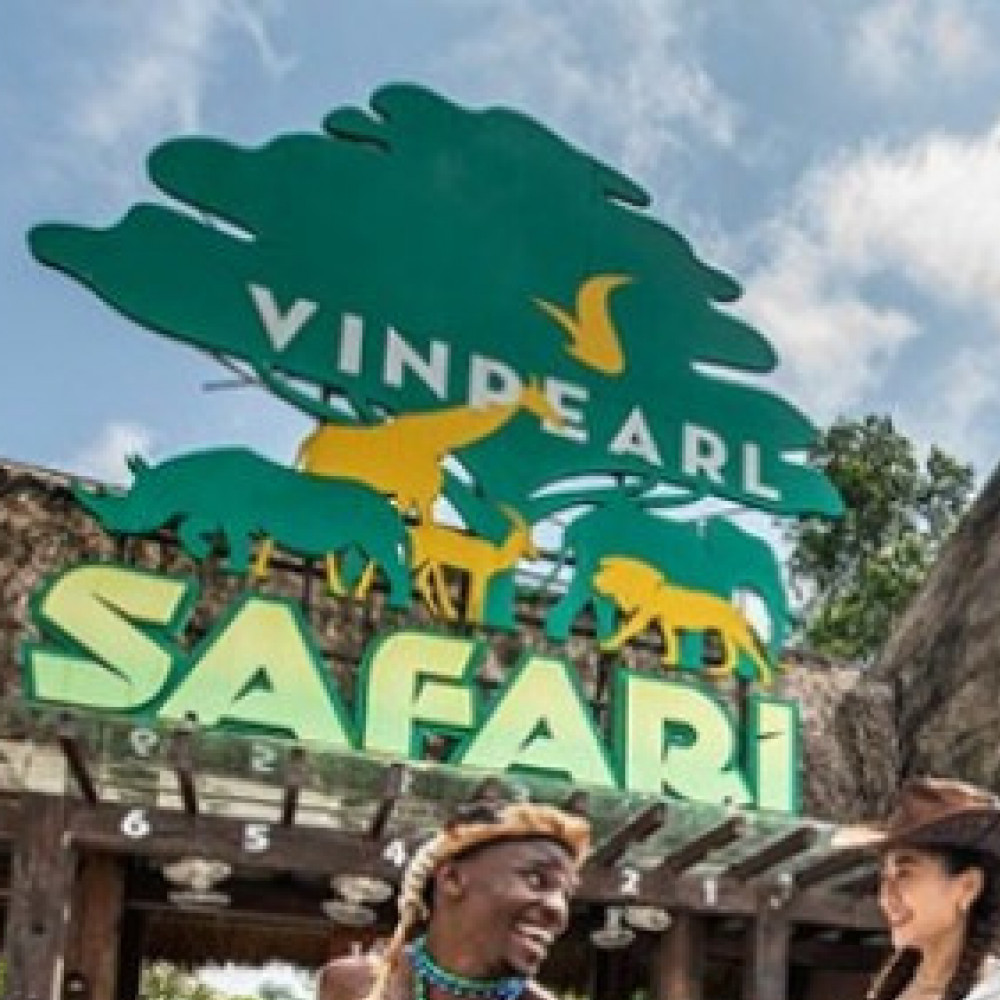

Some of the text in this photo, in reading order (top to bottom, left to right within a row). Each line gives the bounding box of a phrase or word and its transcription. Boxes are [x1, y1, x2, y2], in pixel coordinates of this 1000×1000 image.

[247, 282, 782, 501] VINPEARL
[26, 562, 795, 812] SAFARI
[120, 808, 150, 838] 6
[243, 822, 271, 852] 5
[383, 839, 407, 868] 4
